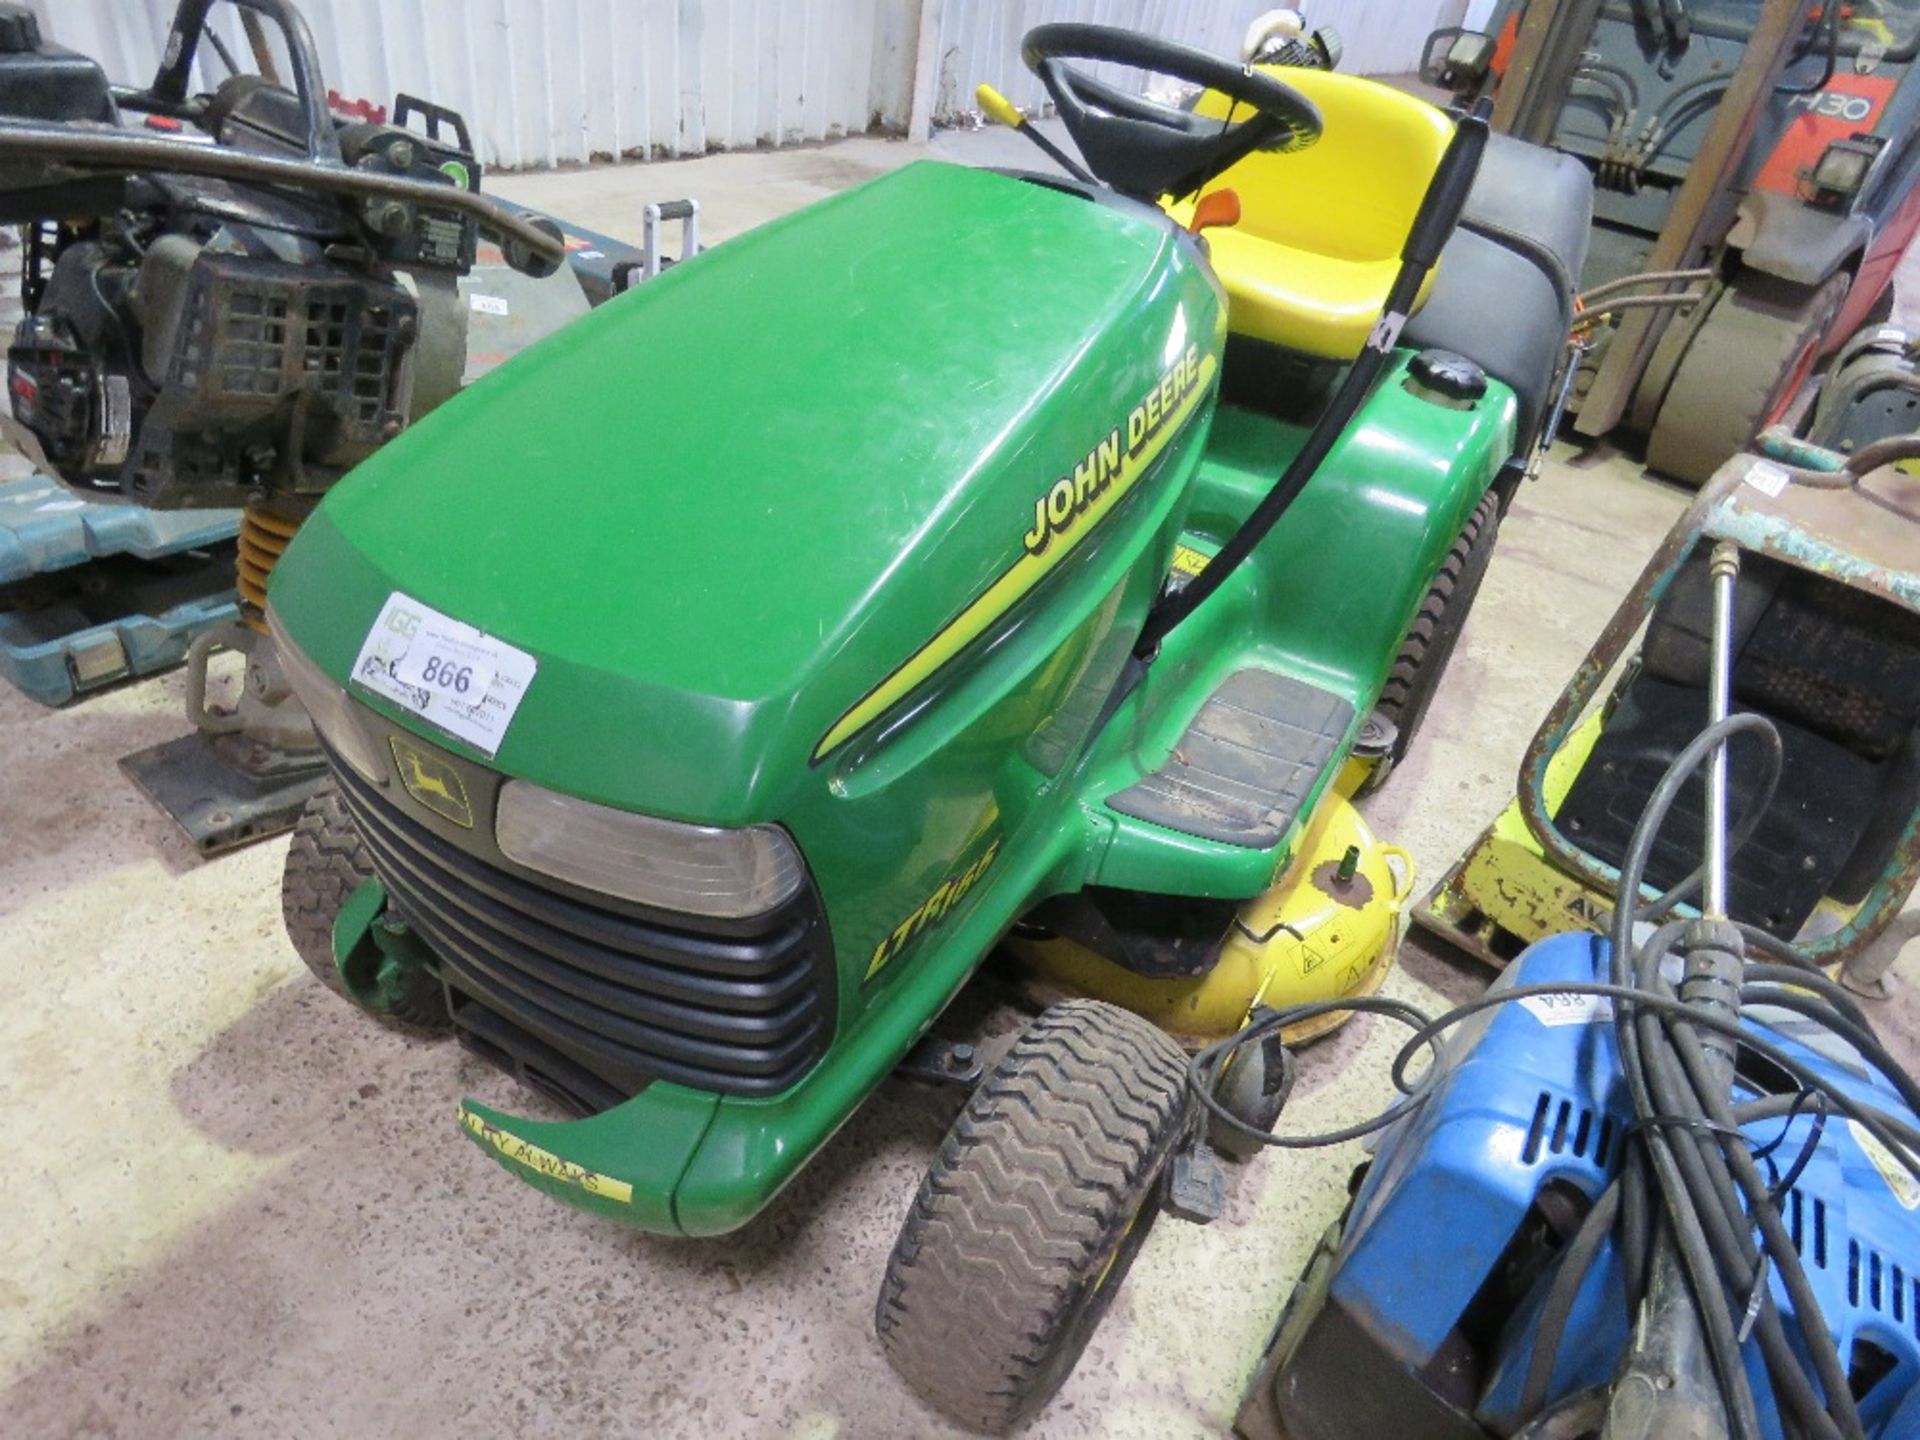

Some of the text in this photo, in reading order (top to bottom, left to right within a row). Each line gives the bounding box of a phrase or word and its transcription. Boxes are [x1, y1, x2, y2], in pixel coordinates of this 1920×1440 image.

[1024, 342, 1200, 554] JOHN DEERE
[421, 654, 474, 693] 866
